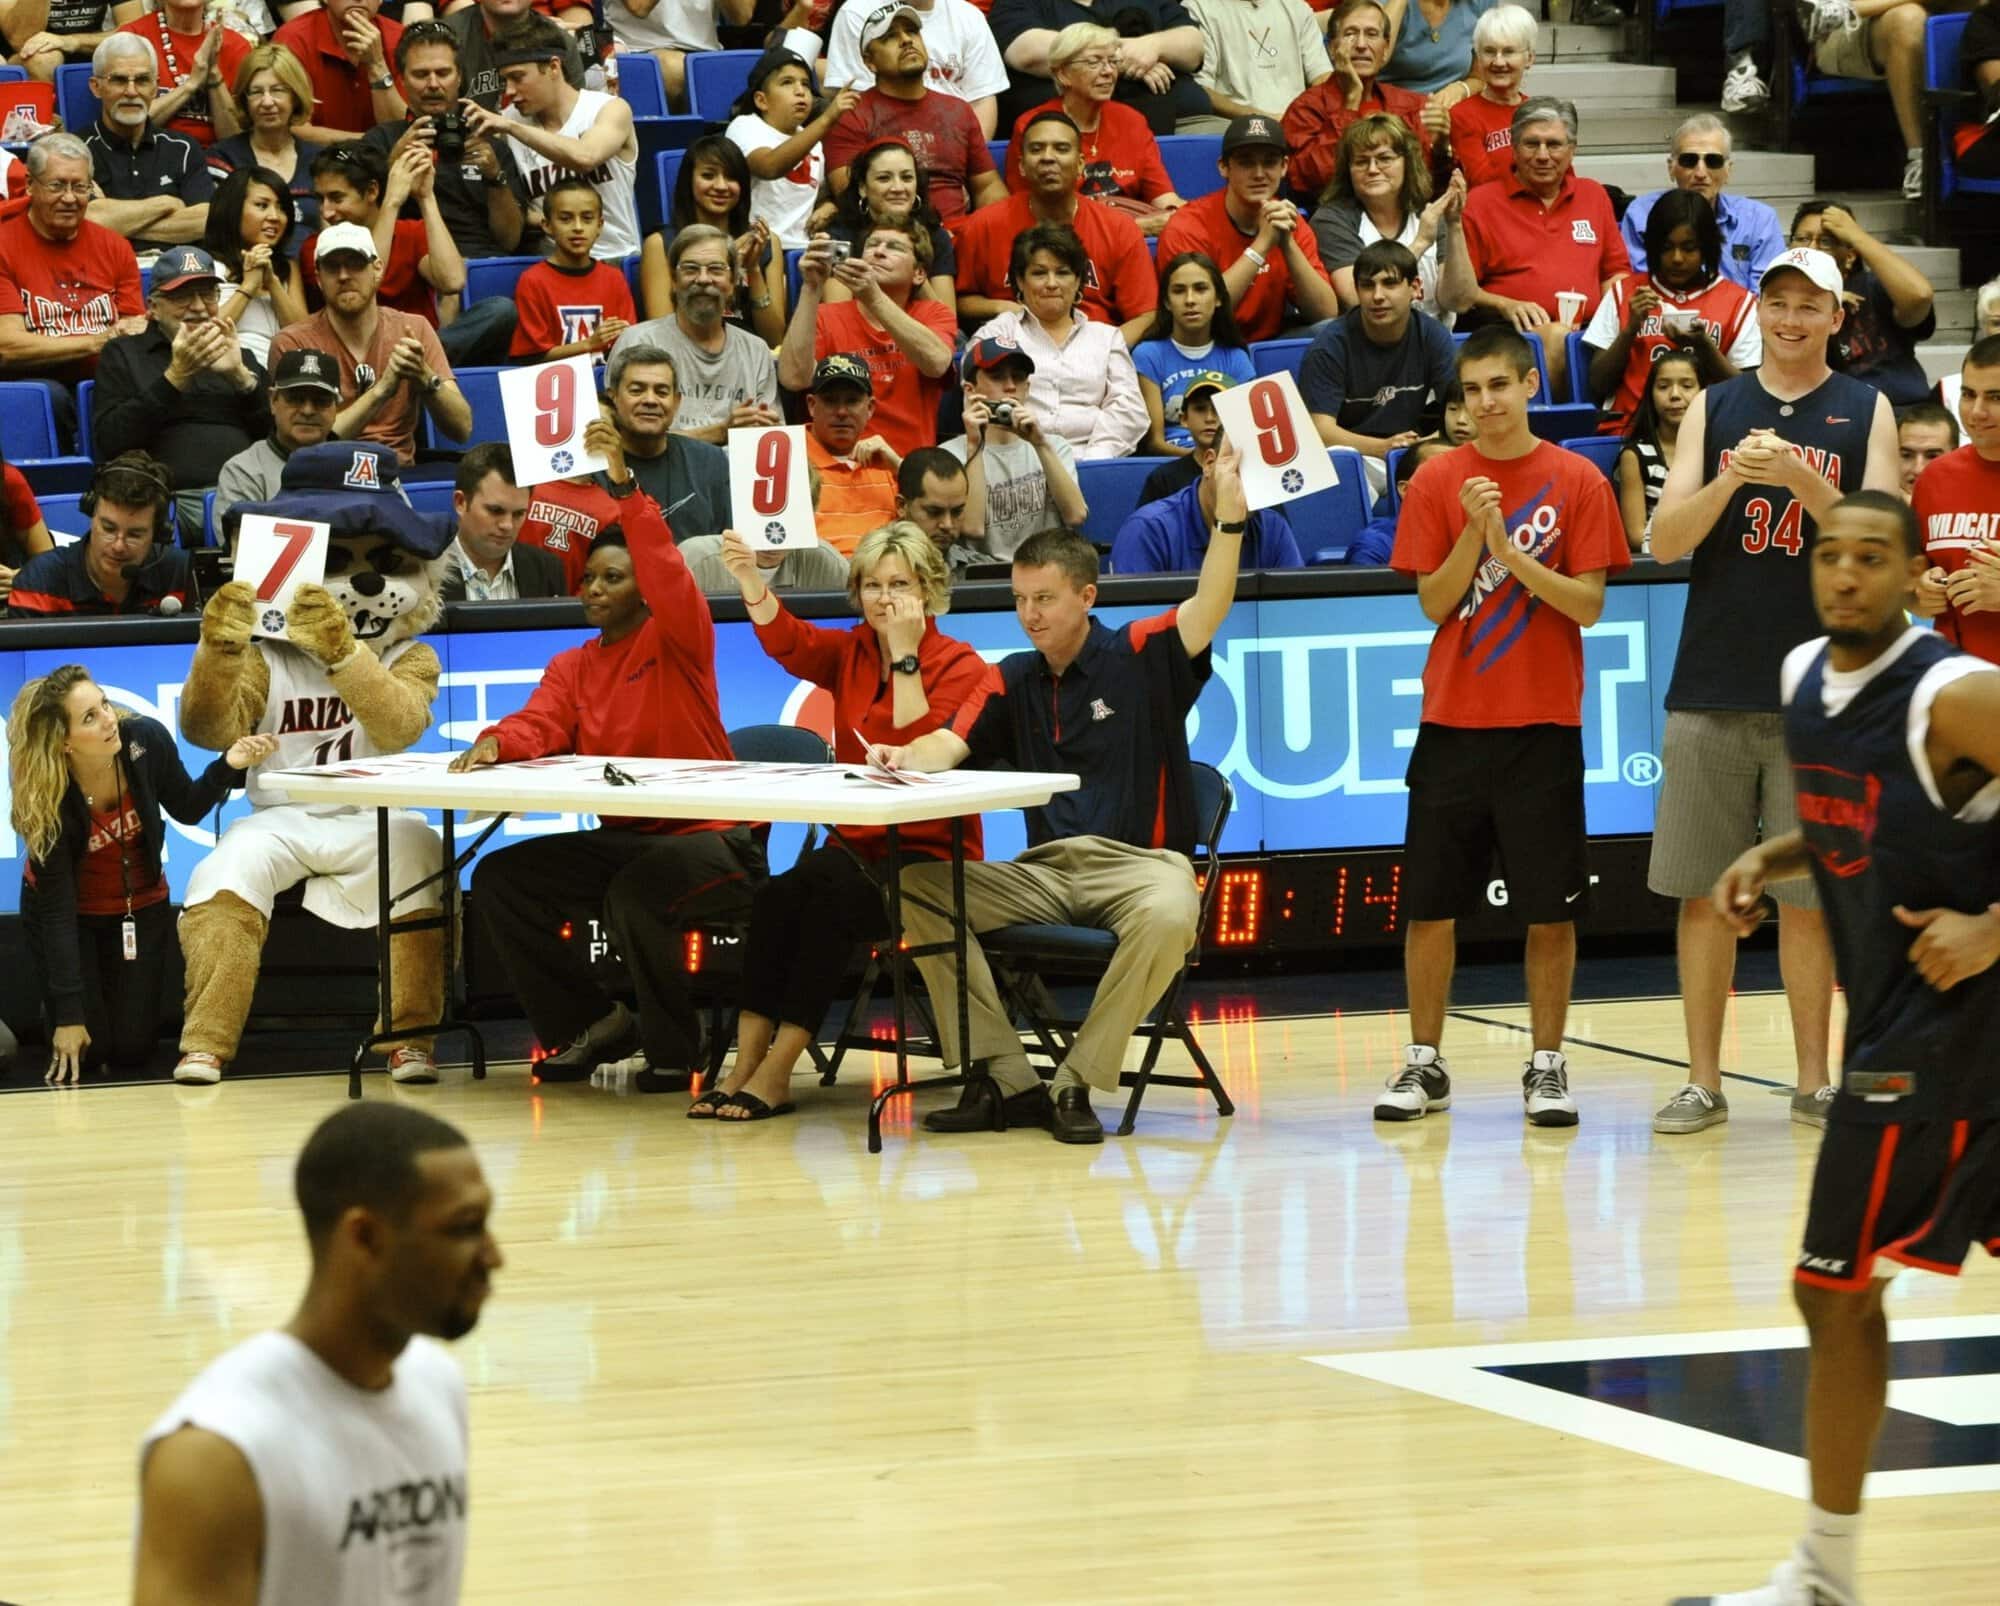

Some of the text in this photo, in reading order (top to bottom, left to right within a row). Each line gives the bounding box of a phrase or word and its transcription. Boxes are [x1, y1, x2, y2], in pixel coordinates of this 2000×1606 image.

[535, 363, 577, 448] 9
[1248, 380, 1301, 468] 9
[343, 450, 380, 489] A
[752, 430, 793, 517] 9
[528, 501, 598, 539] ARIZONA
[545, 523, 571, 551] A
[1742, 497, 1803, 556] 34
[257, 522, 315, 603] 7
